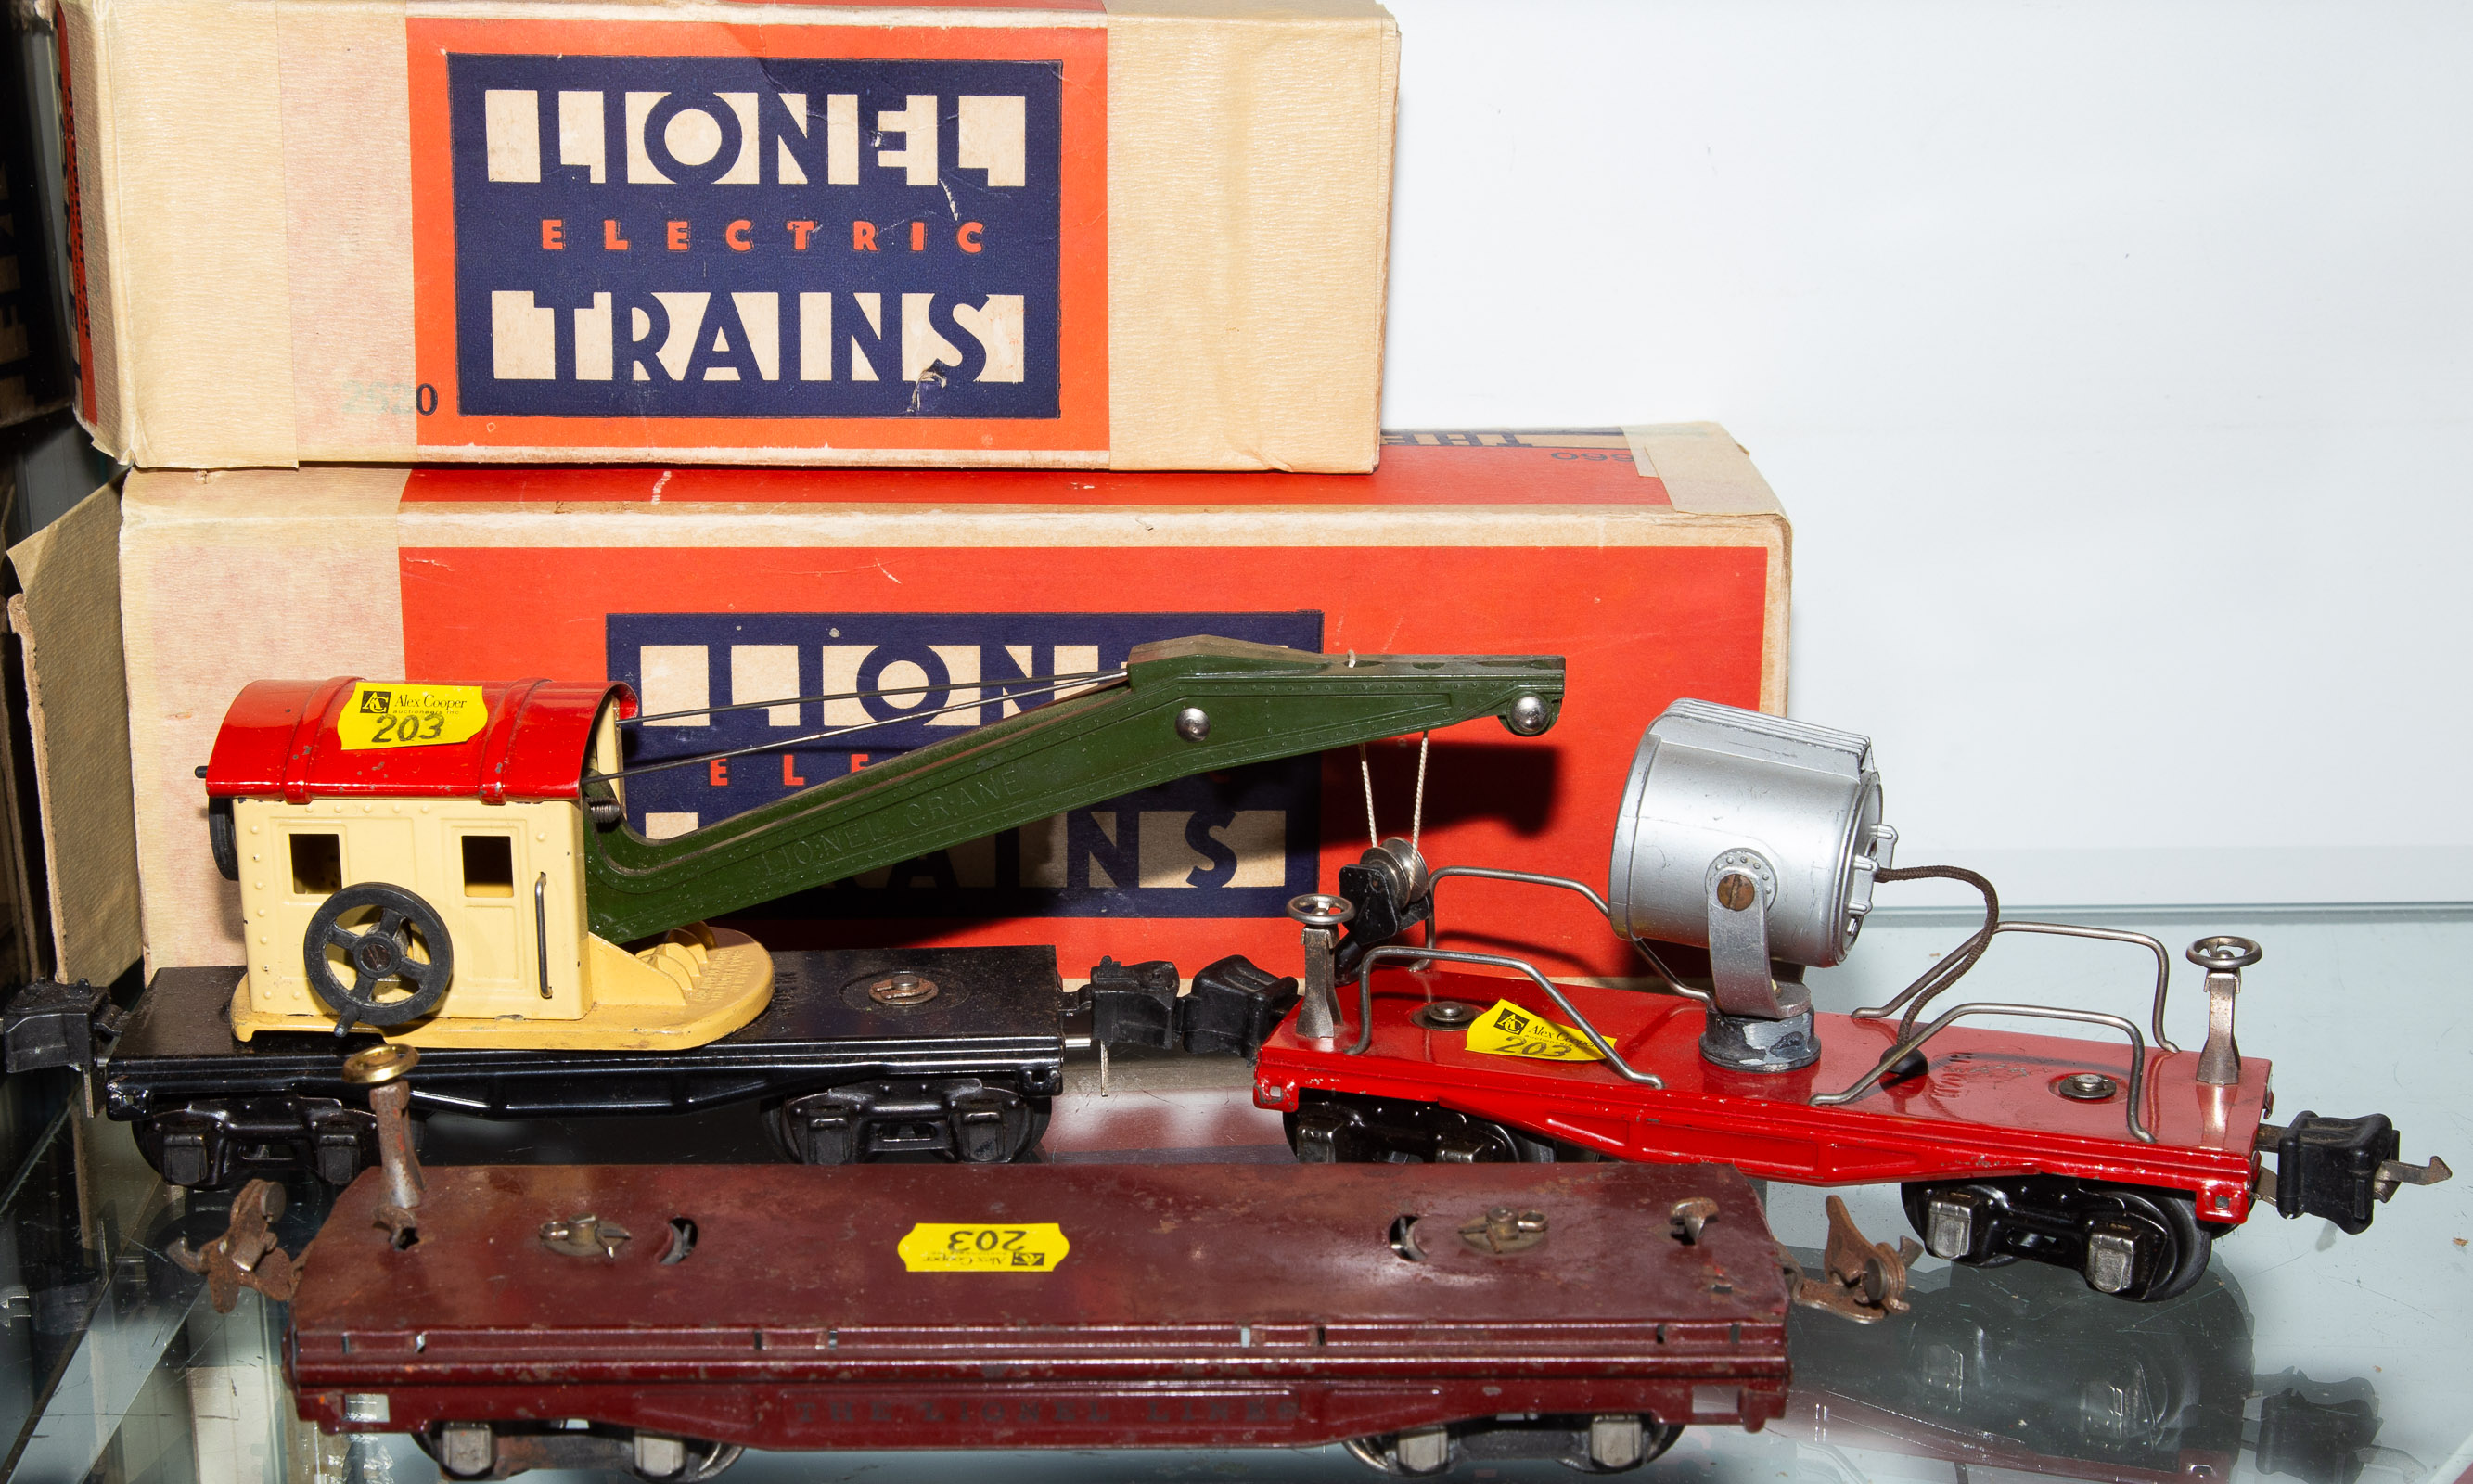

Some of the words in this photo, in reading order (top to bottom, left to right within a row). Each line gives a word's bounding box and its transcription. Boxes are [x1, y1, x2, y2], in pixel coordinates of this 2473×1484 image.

[536, 90, 991, 186] LIONEL
[541, 219, 985, 253] ELECTRIC
[532, 291, 989, 381] TRAINS
[394, 694, 420, 709] Alex
[423, 694, 467, 710] Cooper
[371, 713, 445, 743] 203
[761, 820, 891, 876] LIONEL
[906, 769, 1025, 827] CRANE
[1529, 1025, 1555, 1039] Alex
[1494, 1035, 1573, 1057] 203
[948, 1230, 1026, 1252] 203
[795, 1400, 892, 1424] THE
[918, 1400, 1111, 1424] LIONEL
[1146, 1400, 1297, 1424] LINES
